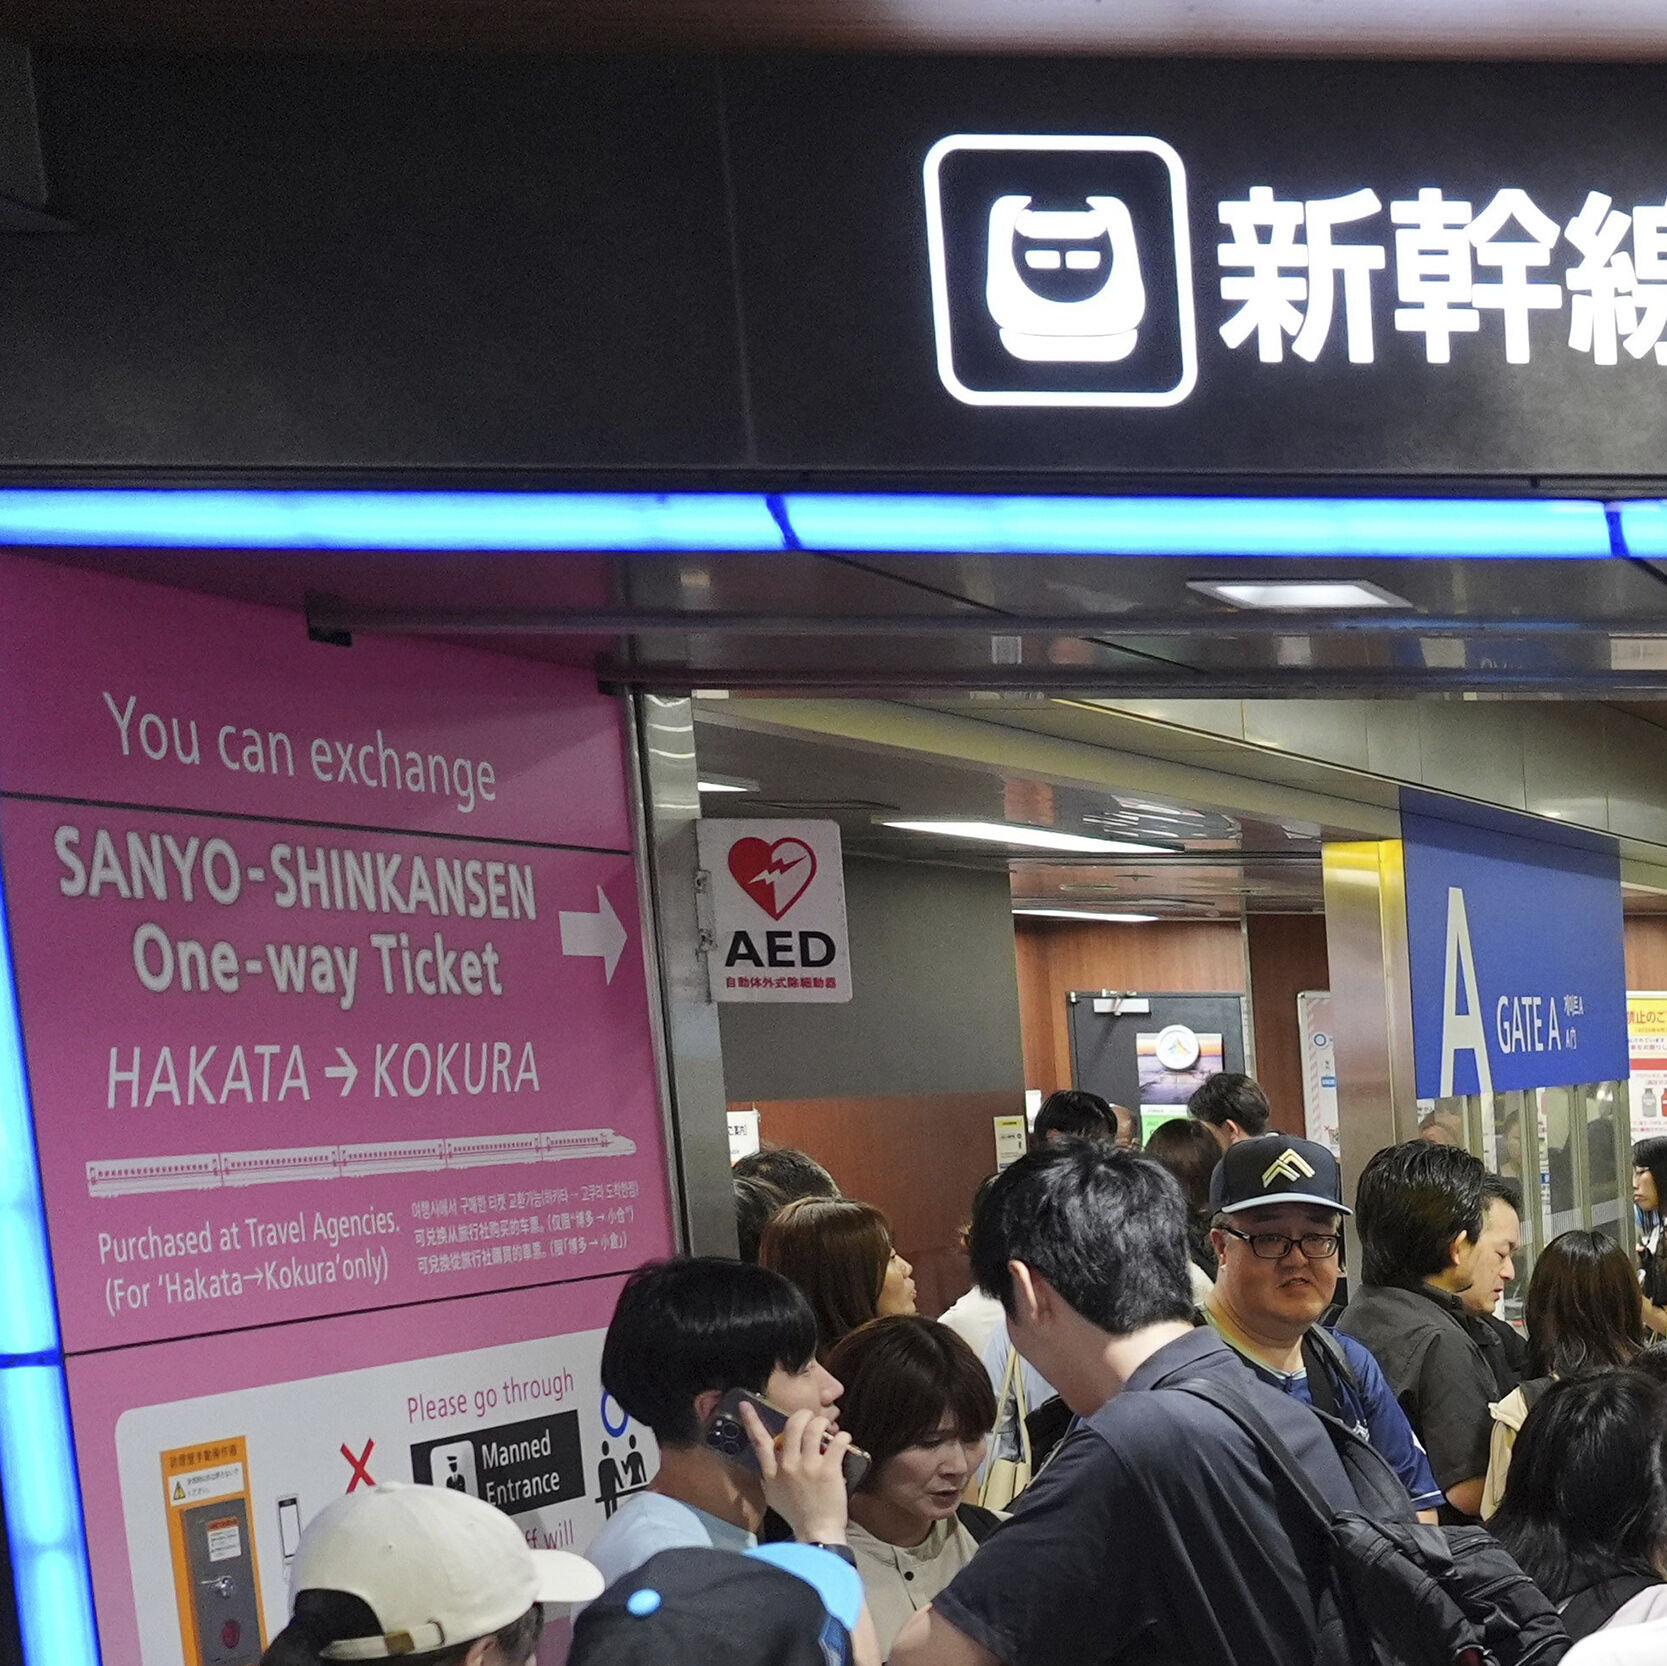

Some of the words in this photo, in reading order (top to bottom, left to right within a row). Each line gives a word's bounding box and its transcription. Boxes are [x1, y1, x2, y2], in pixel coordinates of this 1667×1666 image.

[103, 691, 201, 763] You
[218, 722, 296, 777] can
[311, 728, 498, 813] exchange
[54, 823, 538, 922] SANYO-SHINKANSEN
[131, 922, 359, 1009] One-way
[369, 930, 504, 998] Ticket
[725, 930, 836, 968] AED
[1440, 887, 1494, 1099] A
[1496, 995, 1544, 1054] GATE
[1548, 997, 1562, 1051] A
[105, 1044, 312, 1110] HAKATA
[372, 1040, 542, 1099] KOKURA
[98, 1220, 213, 1265] Purchased
[219, 1221, 242, 1251] at
[244, 1210, 306, 1248] Travel
[312, 1205, 400, 1248] Agencies.
[105, 1276, 151, 1317] (For
[407, 1393, 468, 1424] Please
[474, 1387, 498, 1418] go
[503, 1367, 575, 1405] through
[481, 1428, 552, 1470] Manned
[486, 1471, 561, 1506] Entrance
[543, 1519, 575, 1549] will
